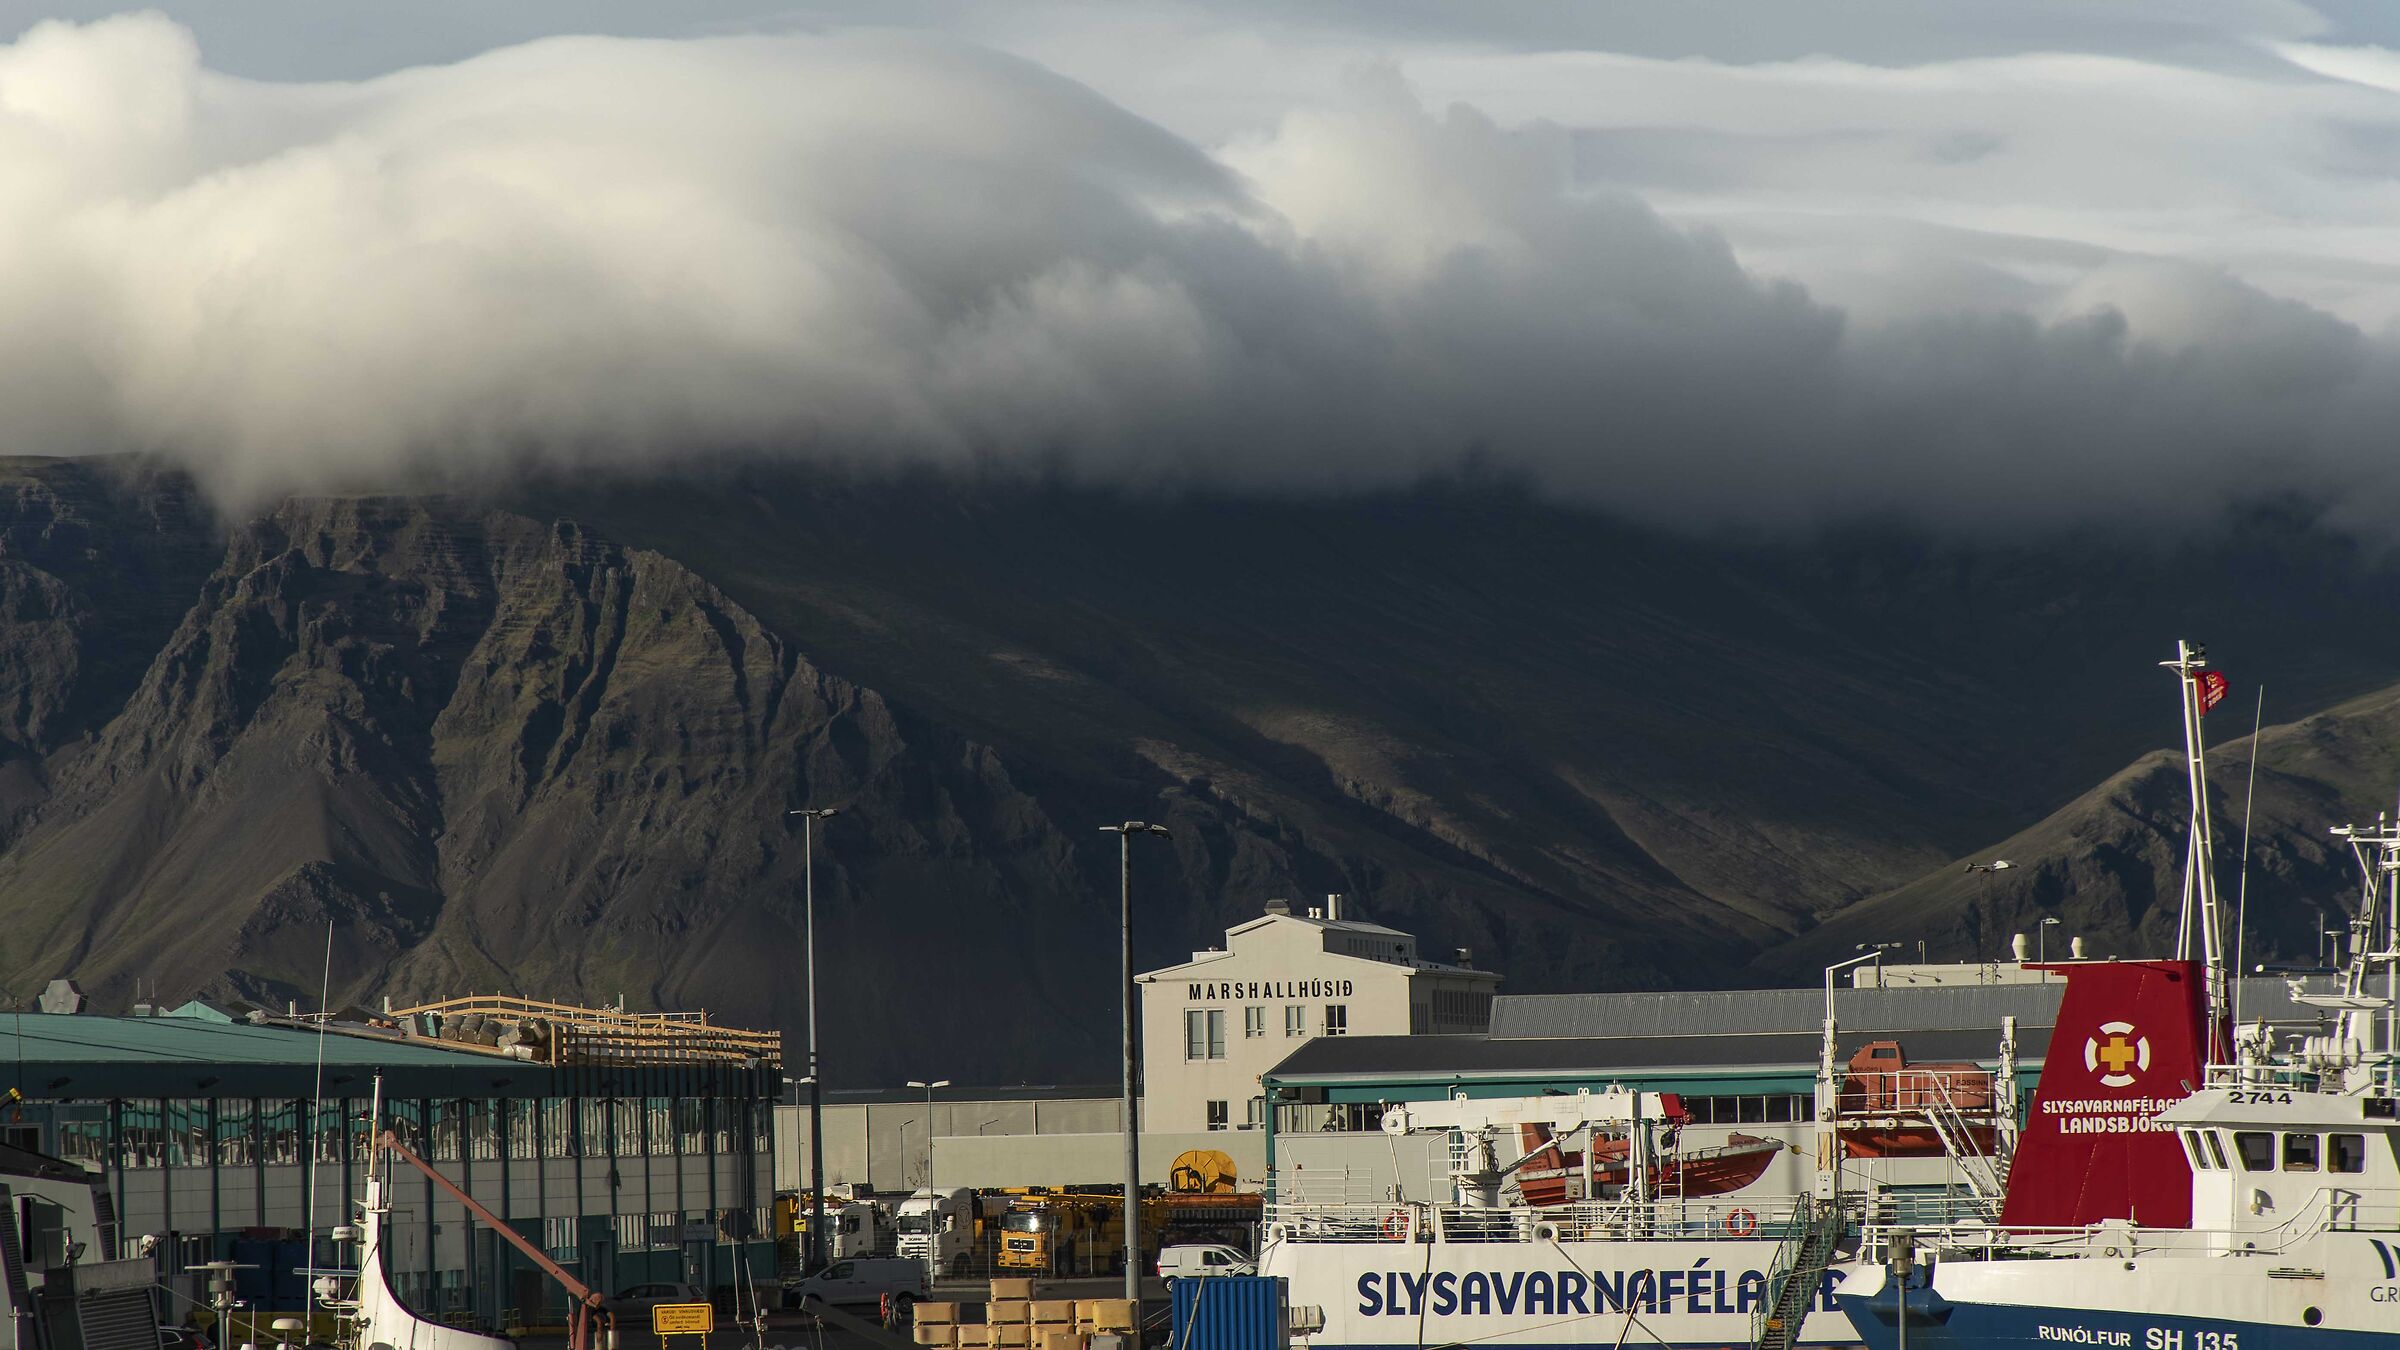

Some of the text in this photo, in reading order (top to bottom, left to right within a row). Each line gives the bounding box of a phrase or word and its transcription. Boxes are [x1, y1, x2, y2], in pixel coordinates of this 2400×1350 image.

[1189, 978, 1353, 1000] MARSHALLHÚSIÐ
[2042, 1095, 2182, 1114] SLYSAVARNAFÉLAG
[2228, 1091, 2293, 1105] 2744
[2370, 1286, 2400, 1303] G.R
[2038, 1325, 2239, 1350] RUNÓLFUR SH 135
